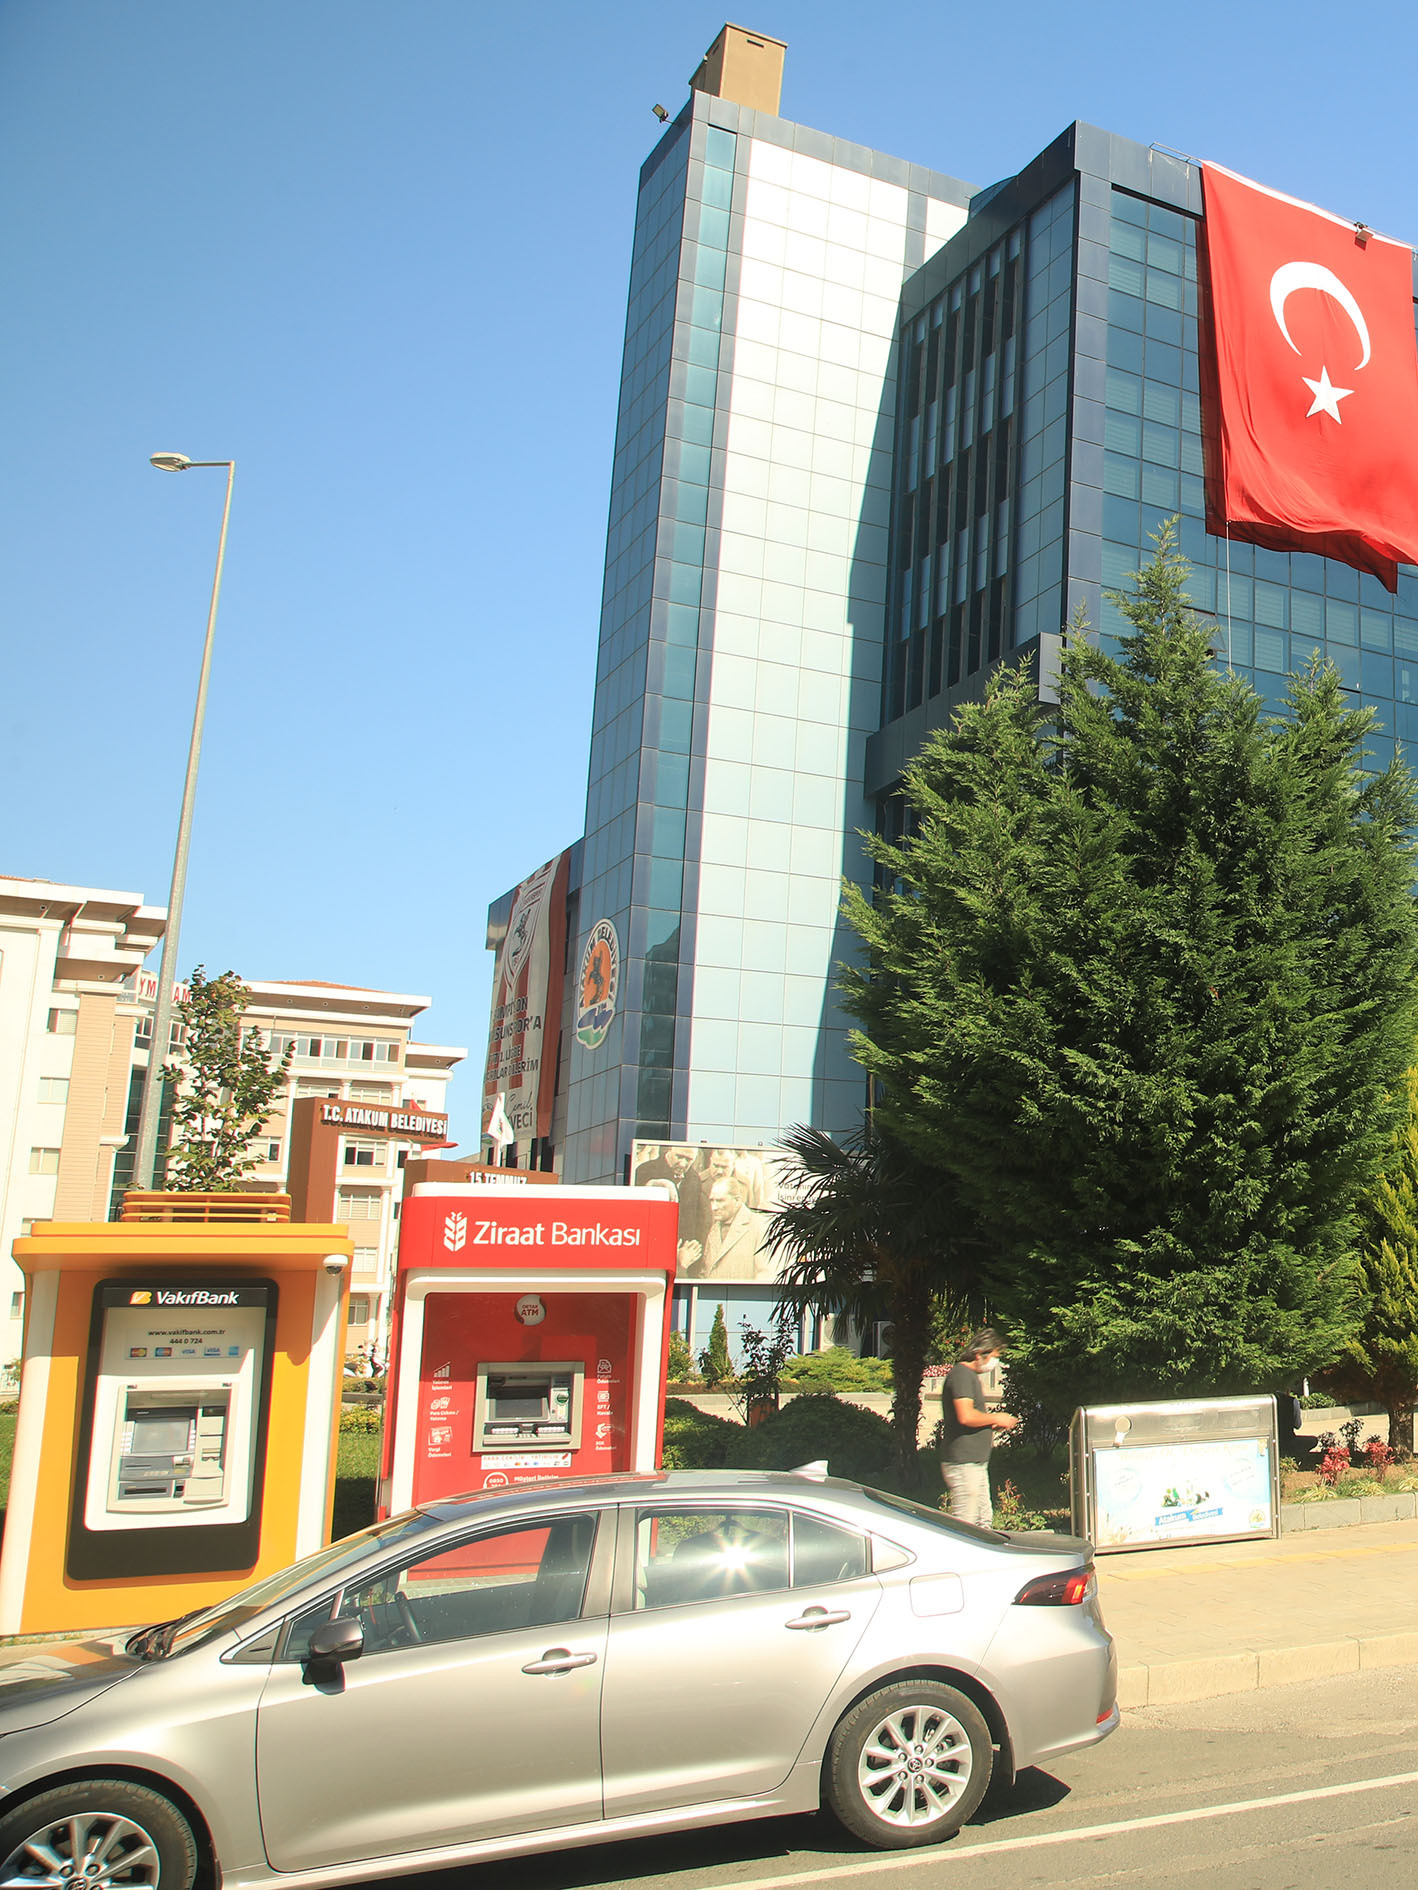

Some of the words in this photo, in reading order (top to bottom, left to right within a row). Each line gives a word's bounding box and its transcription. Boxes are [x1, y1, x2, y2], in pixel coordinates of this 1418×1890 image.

[322, 1104, 344, 1122] T.C.
[344, 1107, 389, 1127] ATAKUM
[390, 1112, 447, 1135] BELEDİYESİ
[473, 1221, 545, 1246] Ziraat
[551, 1221, 641, 1247] Bankası
[156, 1291, 240, 1305] VakıfBank
